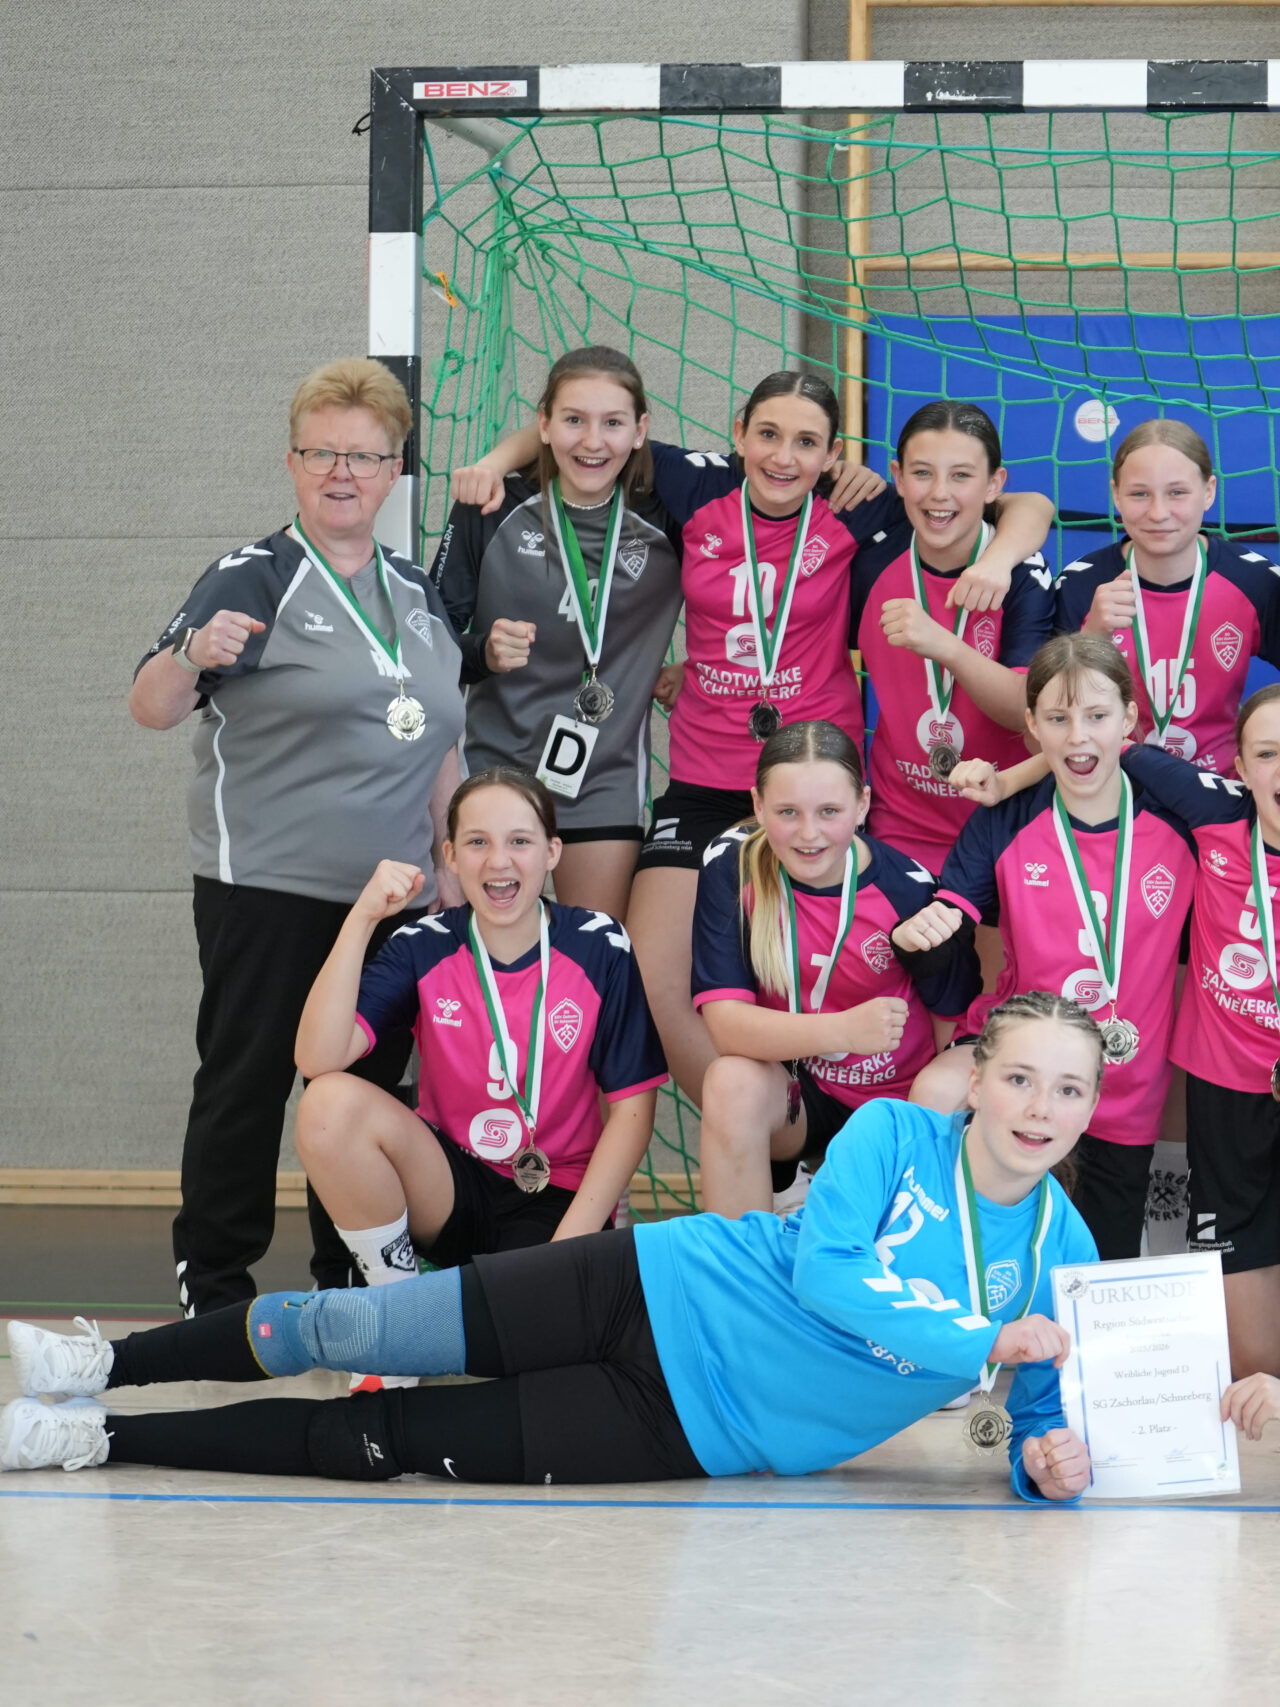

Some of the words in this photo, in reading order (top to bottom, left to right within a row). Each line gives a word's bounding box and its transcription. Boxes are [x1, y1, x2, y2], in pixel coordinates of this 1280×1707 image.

[424, 82, 511, 97] BENZ
[728, 561, 778, 619] 10
[696, 662, 803, 688] STADTWRKE
[1150, 657, 1197, 719] 15
[545, 727, 587, 776] D
[810, 953, 833, 1010] 7
[433, 1014, 463, 1028] hummel
[486, 1037, 518, 1100] 9
[804, 1063, 897, 1085] NEEBERG
[1093, 1319, 1127, 1332] Region
[1114, 1369, 1152, 1380] Weibliche
[1154, 1366, 1180, 1379] Jugend
[1092, 1400, 1108, 1410] SG
[1110, 1391, 1213, 1409] Zschorlau/Schneeberg
[1149, 1423, 1172, 1434] Platz
